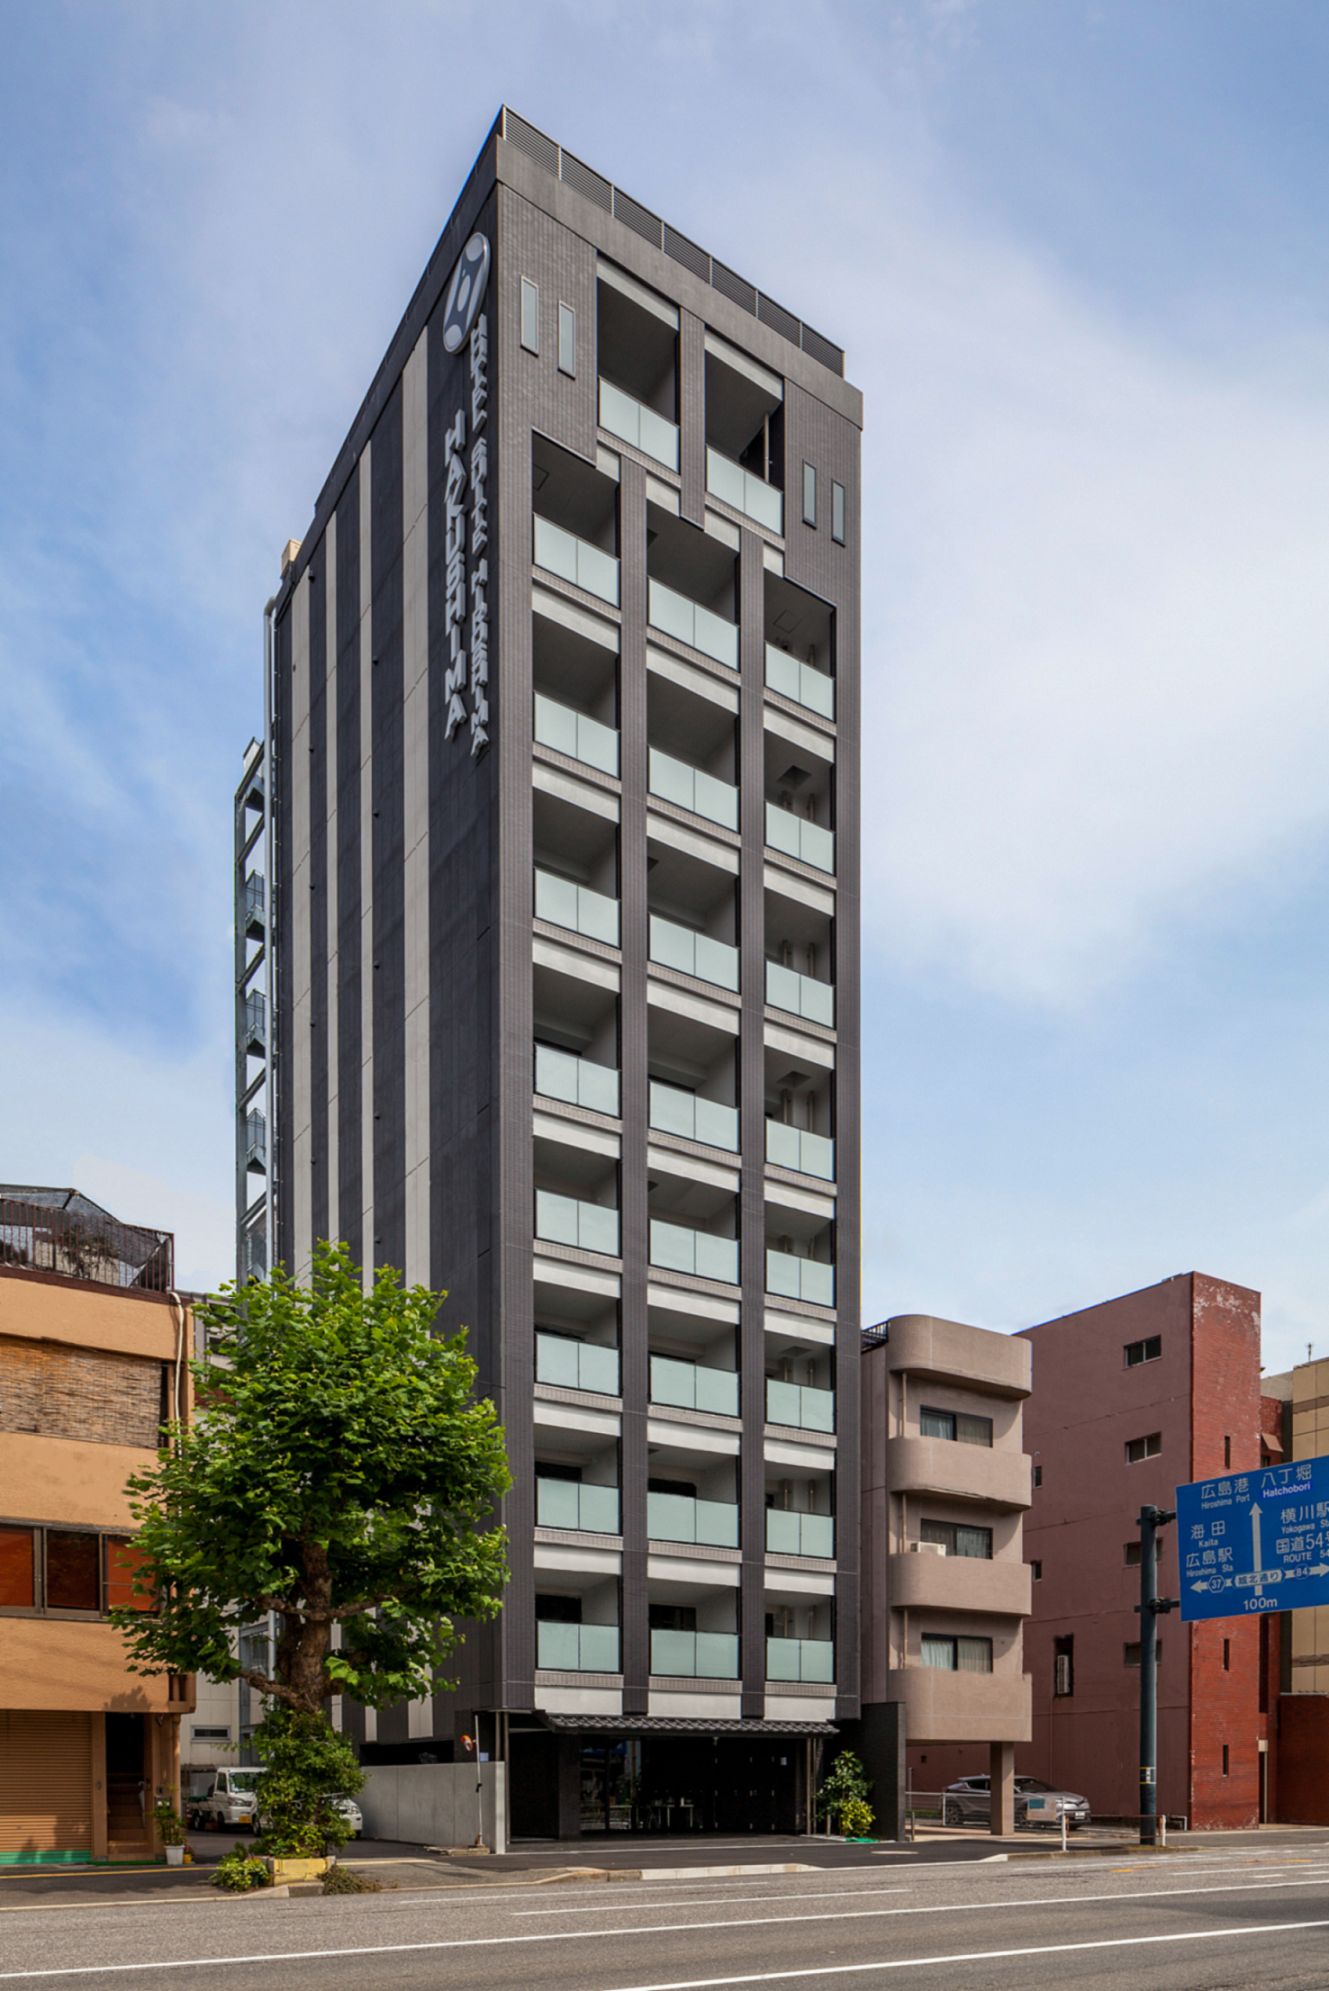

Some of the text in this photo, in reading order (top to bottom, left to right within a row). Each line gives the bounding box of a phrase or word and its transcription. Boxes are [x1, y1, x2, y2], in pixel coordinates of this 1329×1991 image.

[470, 313, 488, 433] HOTEL
[444, 408, 468, 741] HAKUSHIMA
[470, 558, 489, 757] HIROSHIMA
[1261, 1463, 1312, 1489] 八丁堀
[1201, 1477, 1249, 1499] 広島港
[1263, 1482, 1311, 1498] Hatchobori
[1201, 1493, 1250, 1509] Hiroshima Port
[1282, 1523, 1316, 1534] Yokogawa
[1198, 1538, 1219, 1548] Kaita
[1186, 1546, 1233, 1568] 広島駅
[1283, 1551, 1312, 1563] ROUTE
[1296, 1567, 1307, 1577] 84
[1211, 1578, 1221, 1589] 37
[1243, 1597, 1278, 1611] 100m
